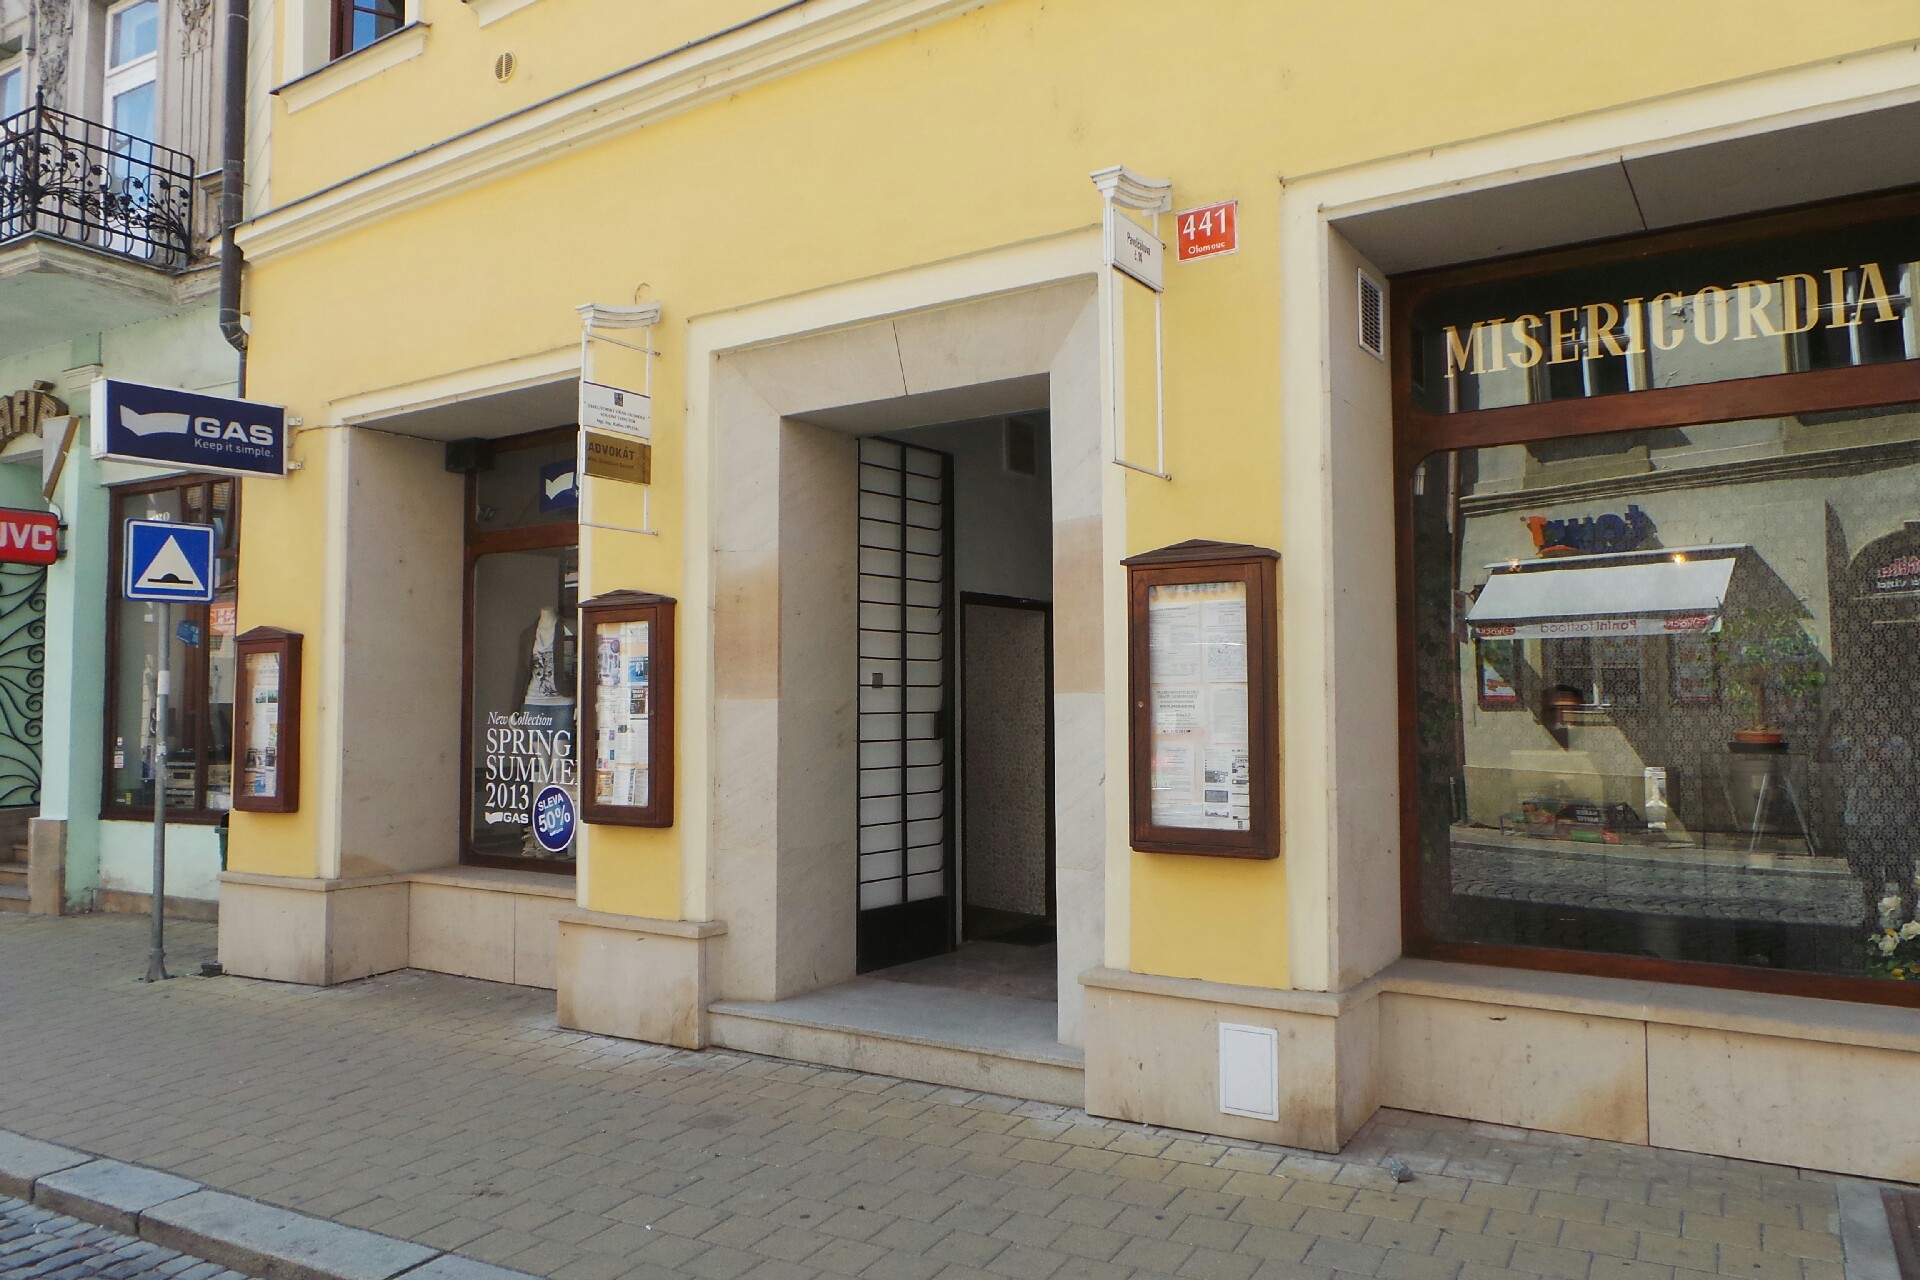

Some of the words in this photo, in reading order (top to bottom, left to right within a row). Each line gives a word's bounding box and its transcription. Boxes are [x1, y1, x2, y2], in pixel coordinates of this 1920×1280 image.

[1183, 208, 1226, 240] 441
[1188, 241, 1226, 255] Olomouc
[1443, 262, 1899, 378] MISERICORDIA
[194, 416, 274, 446] GAS
[194, 437, 223, 452] Keep
[225, 442, 233, 453] it
[235, 443, 274, 458] simple.
[588, 441, 636, 461] ADVOKÁT
[487, 711, 509, 726] New
[510, 711, 553, 726] Collection
[486, 728, 572, 757] SPRING
[485, 754, 578, 786] SUMME
[485, 782, 530, 810] 2013
[537, 792, 564, 812] SLEVA
[503, 812, 529, 824] GAS
[538, 804, 571, 833] 50%
